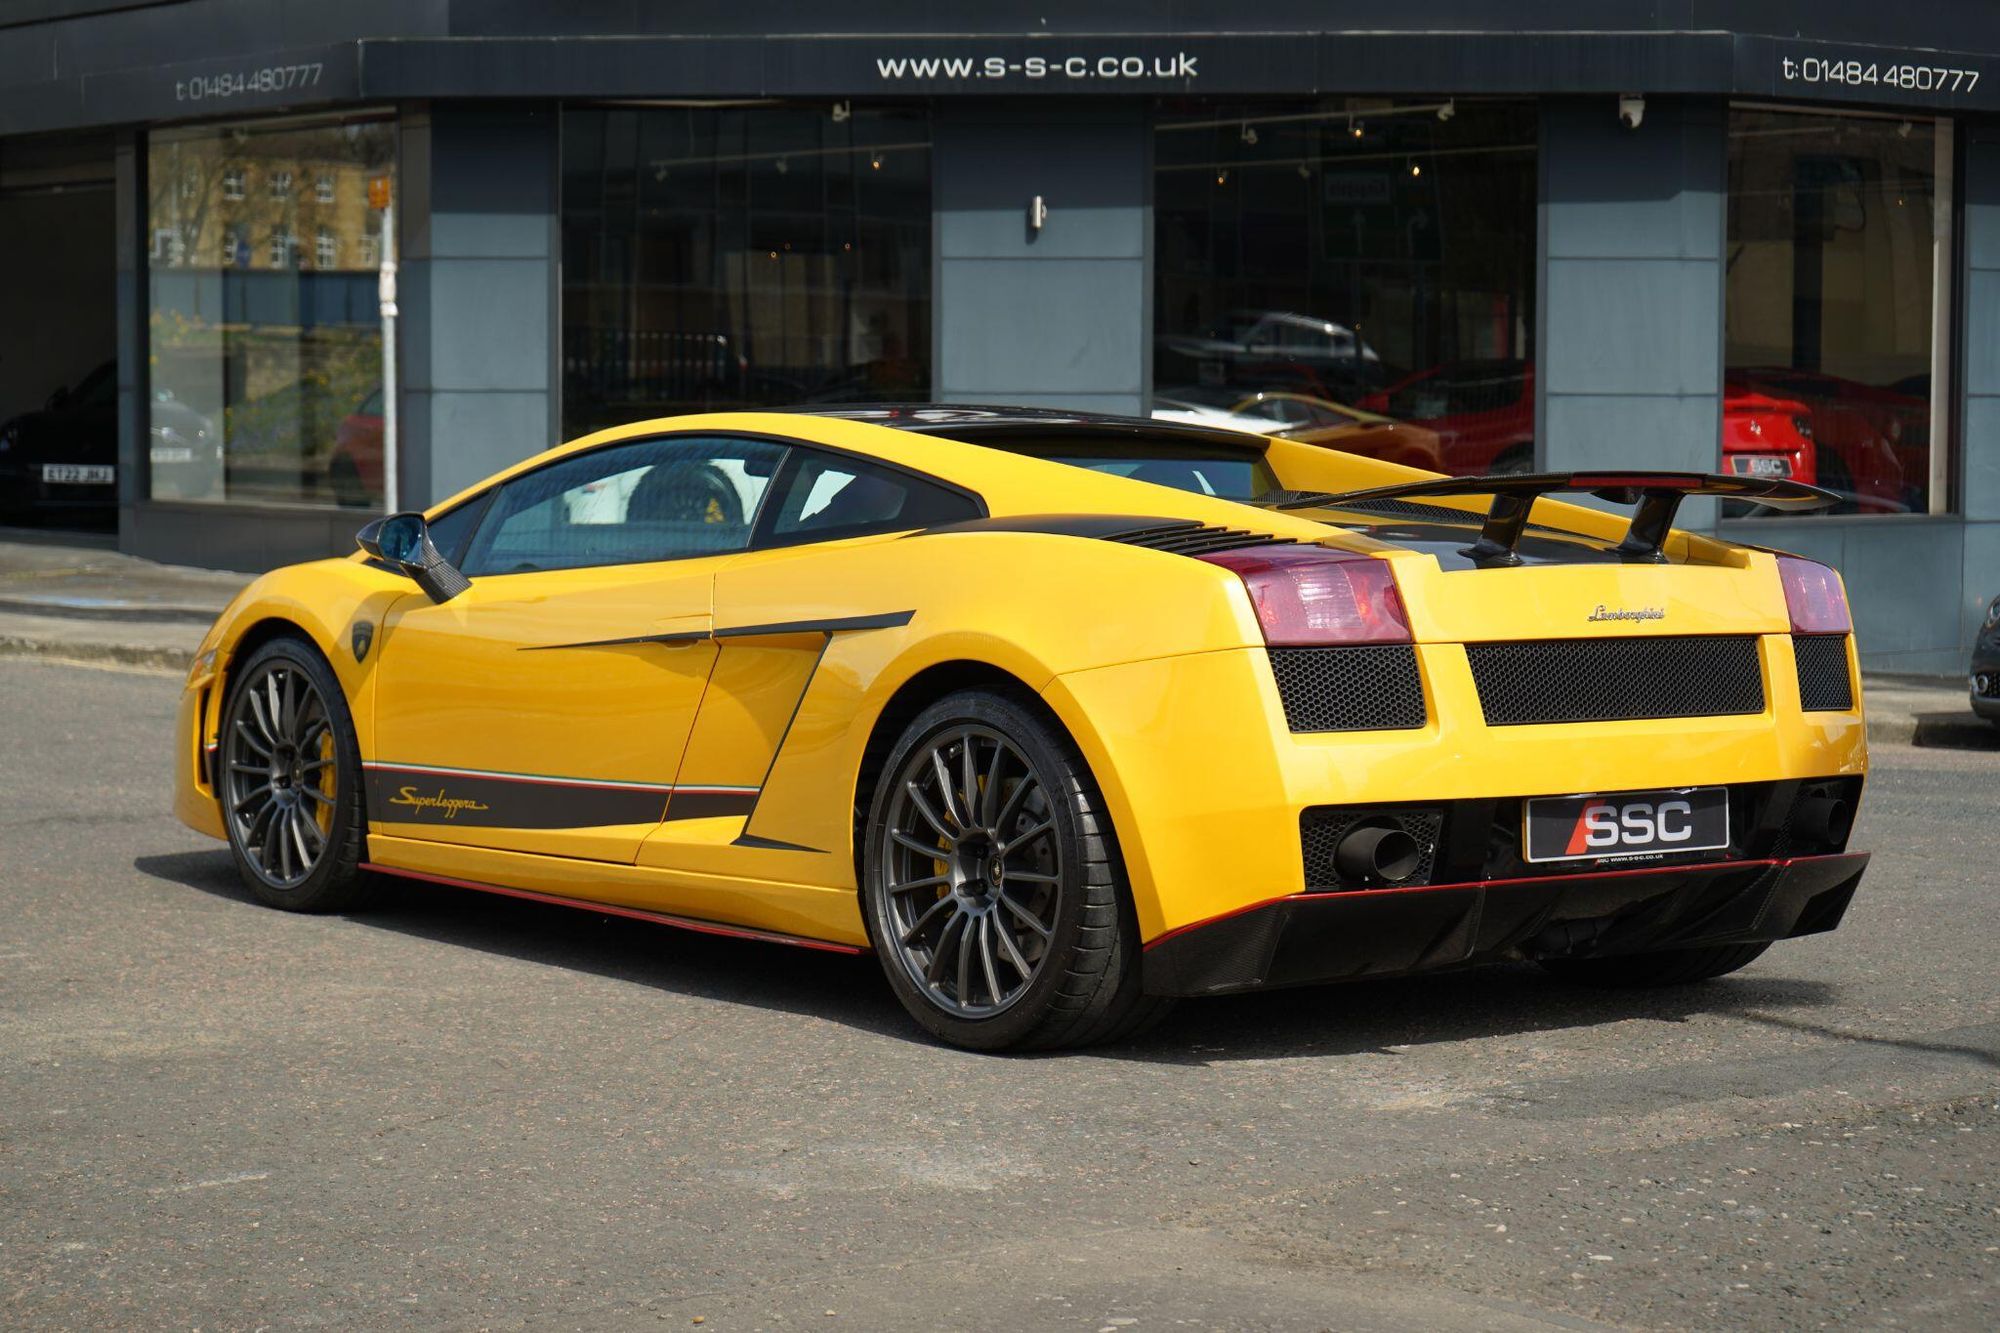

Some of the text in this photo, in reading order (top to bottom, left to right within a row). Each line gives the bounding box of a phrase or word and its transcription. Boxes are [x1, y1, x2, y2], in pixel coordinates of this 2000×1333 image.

[246, 62, 323, 92] 480777
[876, 52, 1198, 78] www.s-s-c.co.uk
[1883, 64, 1980, 93] 480777
[1587, 604, 1665, 623] Lamborghini
[389, 786, 489, 818] Superleggera
[1584, 800, 1692, 847] SSC
